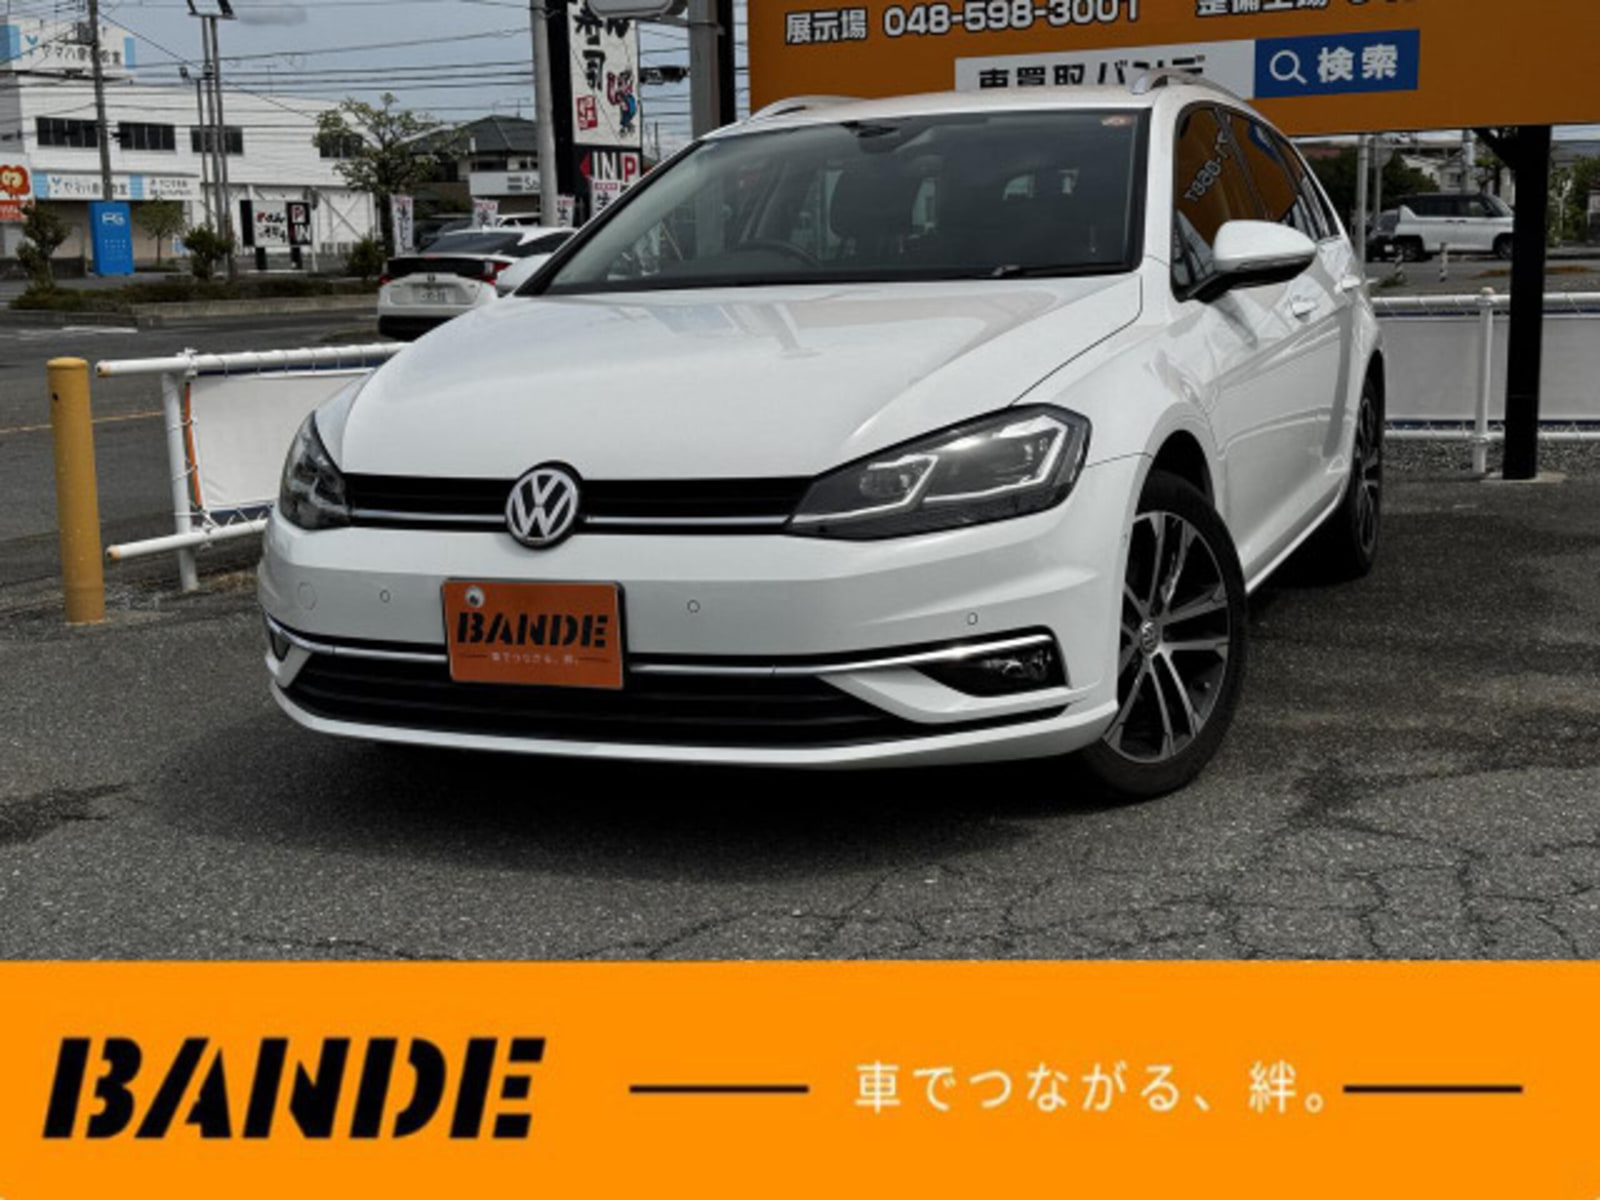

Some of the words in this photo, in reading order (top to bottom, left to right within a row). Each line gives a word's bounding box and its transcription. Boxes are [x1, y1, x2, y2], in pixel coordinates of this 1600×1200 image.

[785, 9, 868, 44] 展示場
[883, 0, 1139, 37] 048-598-3001
[1316, 44, 1399, 84] 検索
[592, 152, 617, 181] IN
[457, 612, 609, 648] BANDE
